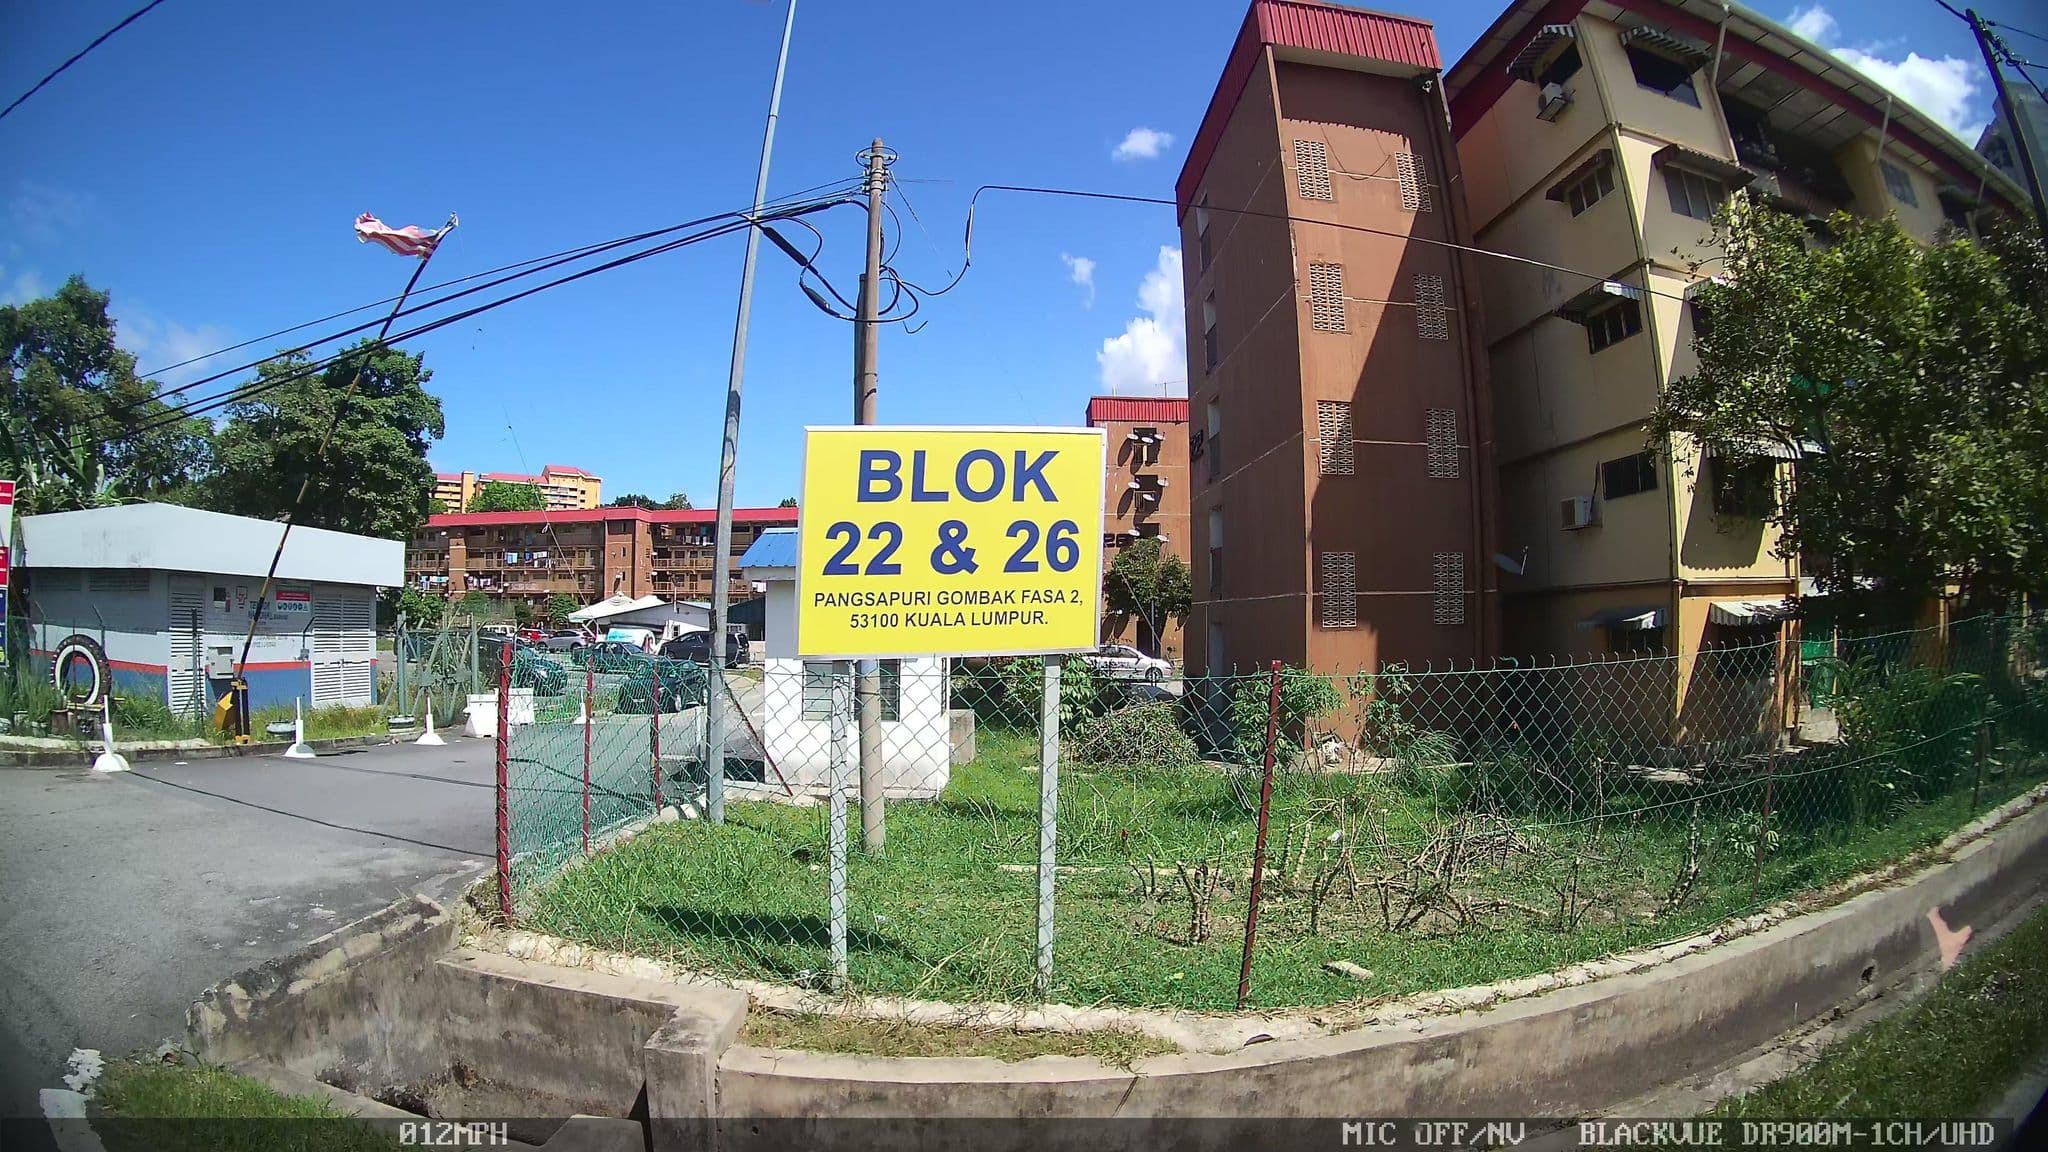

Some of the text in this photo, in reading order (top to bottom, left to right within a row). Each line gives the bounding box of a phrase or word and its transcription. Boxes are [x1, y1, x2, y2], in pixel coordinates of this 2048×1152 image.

[857, 449, 1060, 502] BLOK
[822, 519, 1080, 576] 22 & 26
[814, 589, 1083, 608] PANGSAPURI GOMBAK FASA 2,
[850, 611, 1048, 628] 53100 KUALA LUMPUR.
